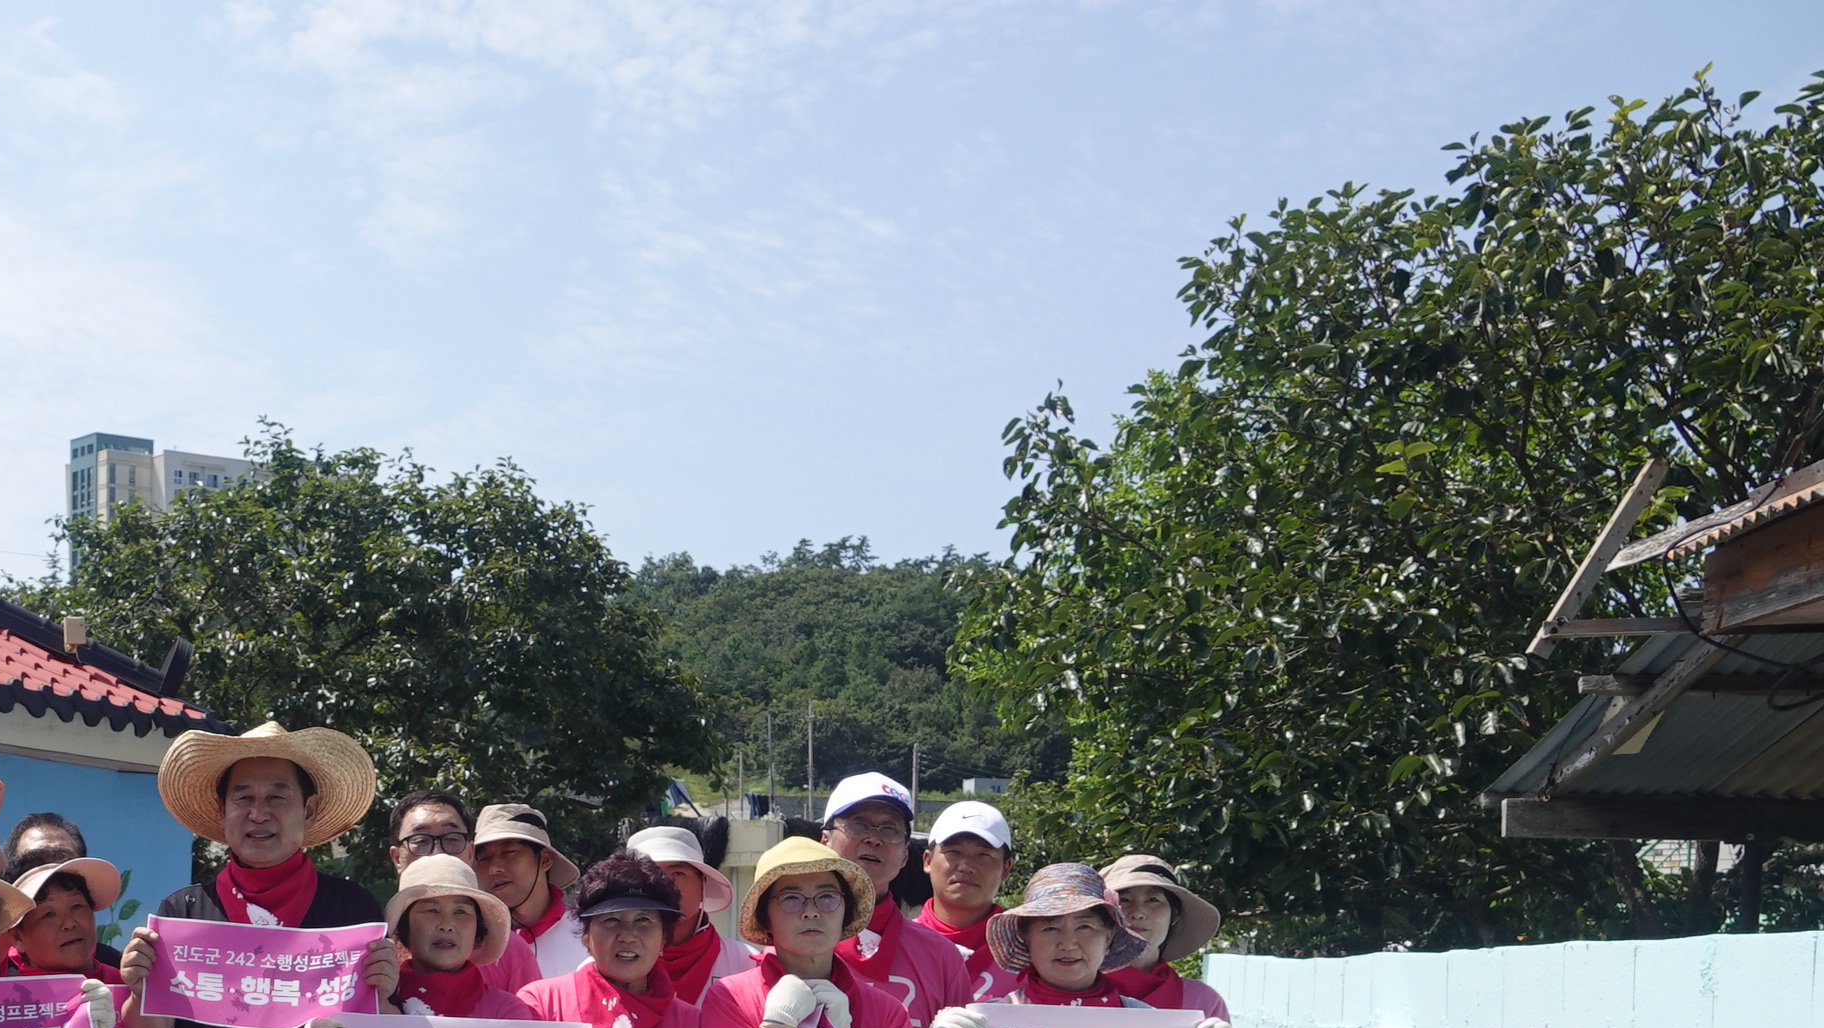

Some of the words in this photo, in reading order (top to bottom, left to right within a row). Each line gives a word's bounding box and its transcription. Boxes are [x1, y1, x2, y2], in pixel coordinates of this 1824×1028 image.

[173, 944, 221, 965] 진도군
[226, 950, 255, 967] 242
[260, 949, 362, 973] 소행성프로젝트
